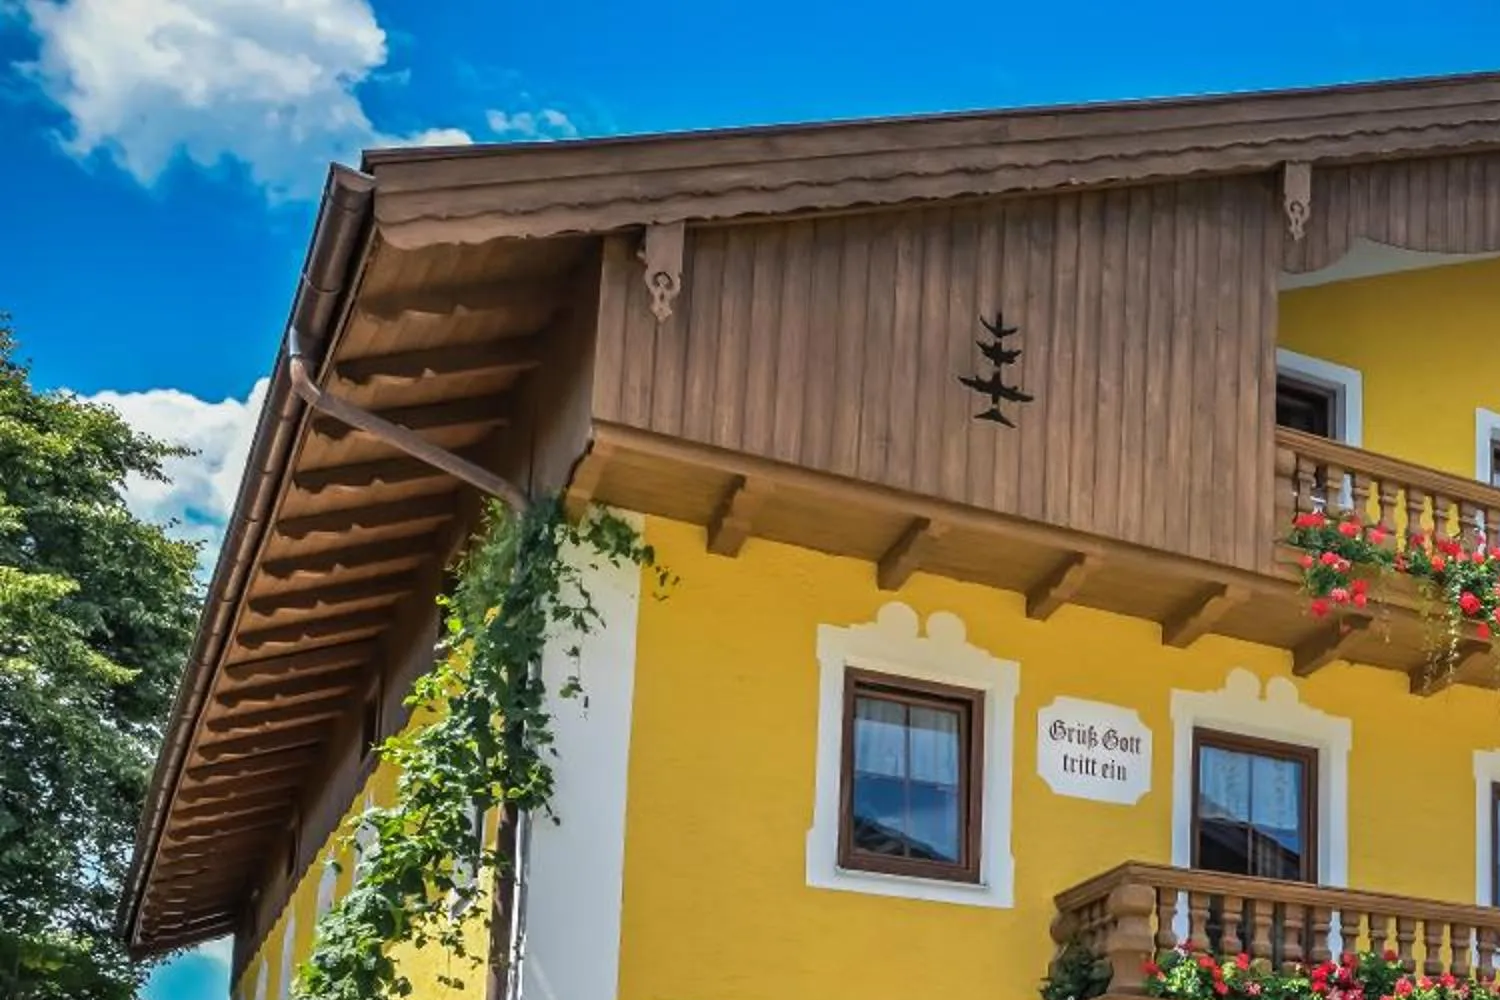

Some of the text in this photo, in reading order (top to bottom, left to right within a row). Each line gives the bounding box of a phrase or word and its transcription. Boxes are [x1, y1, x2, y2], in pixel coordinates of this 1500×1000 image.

[1049, 719, 1142, 755] Grüß Gott
[1062, 754, 1127, 782] tritt ein
